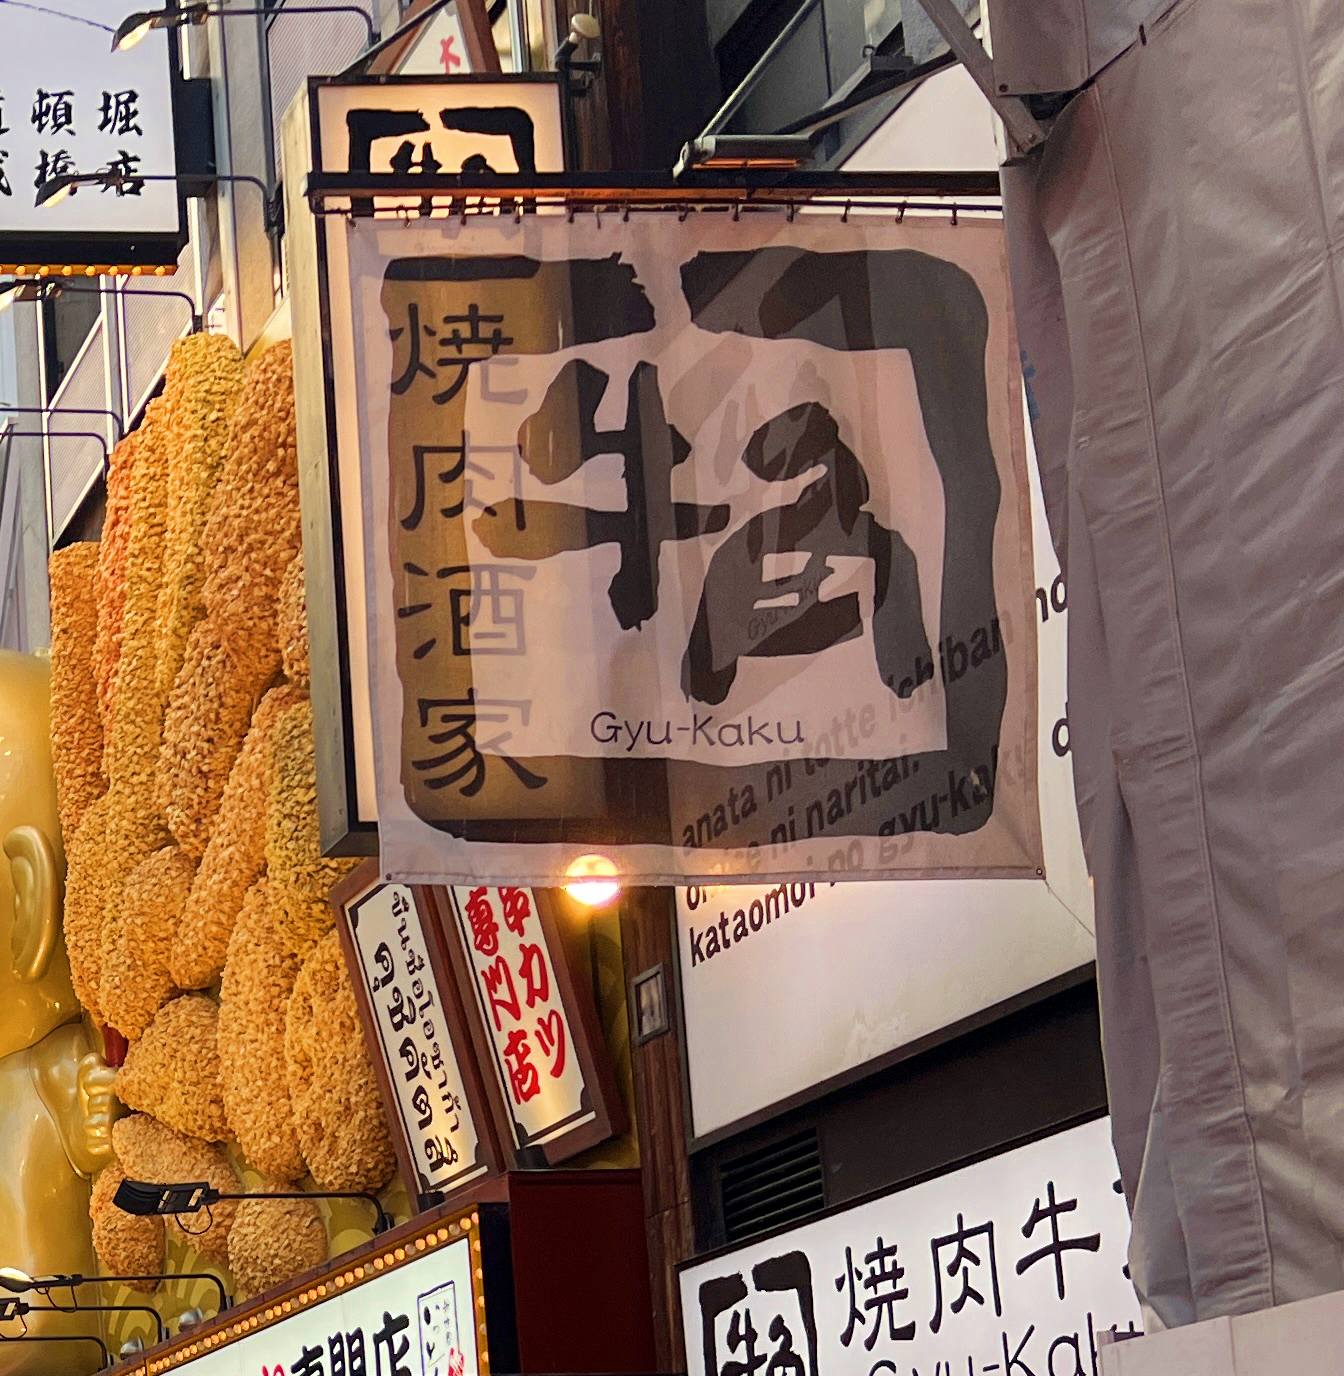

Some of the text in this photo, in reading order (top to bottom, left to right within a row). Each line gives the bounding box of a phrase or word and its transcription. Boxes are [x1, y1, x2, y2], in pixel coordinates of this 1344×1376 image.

[387, 302, 550, 798] 焼肉酒家
[590, 709, 806, 751] Gyu-Kaku
[835, 1180, 1127, 1352] 焼肉牛
